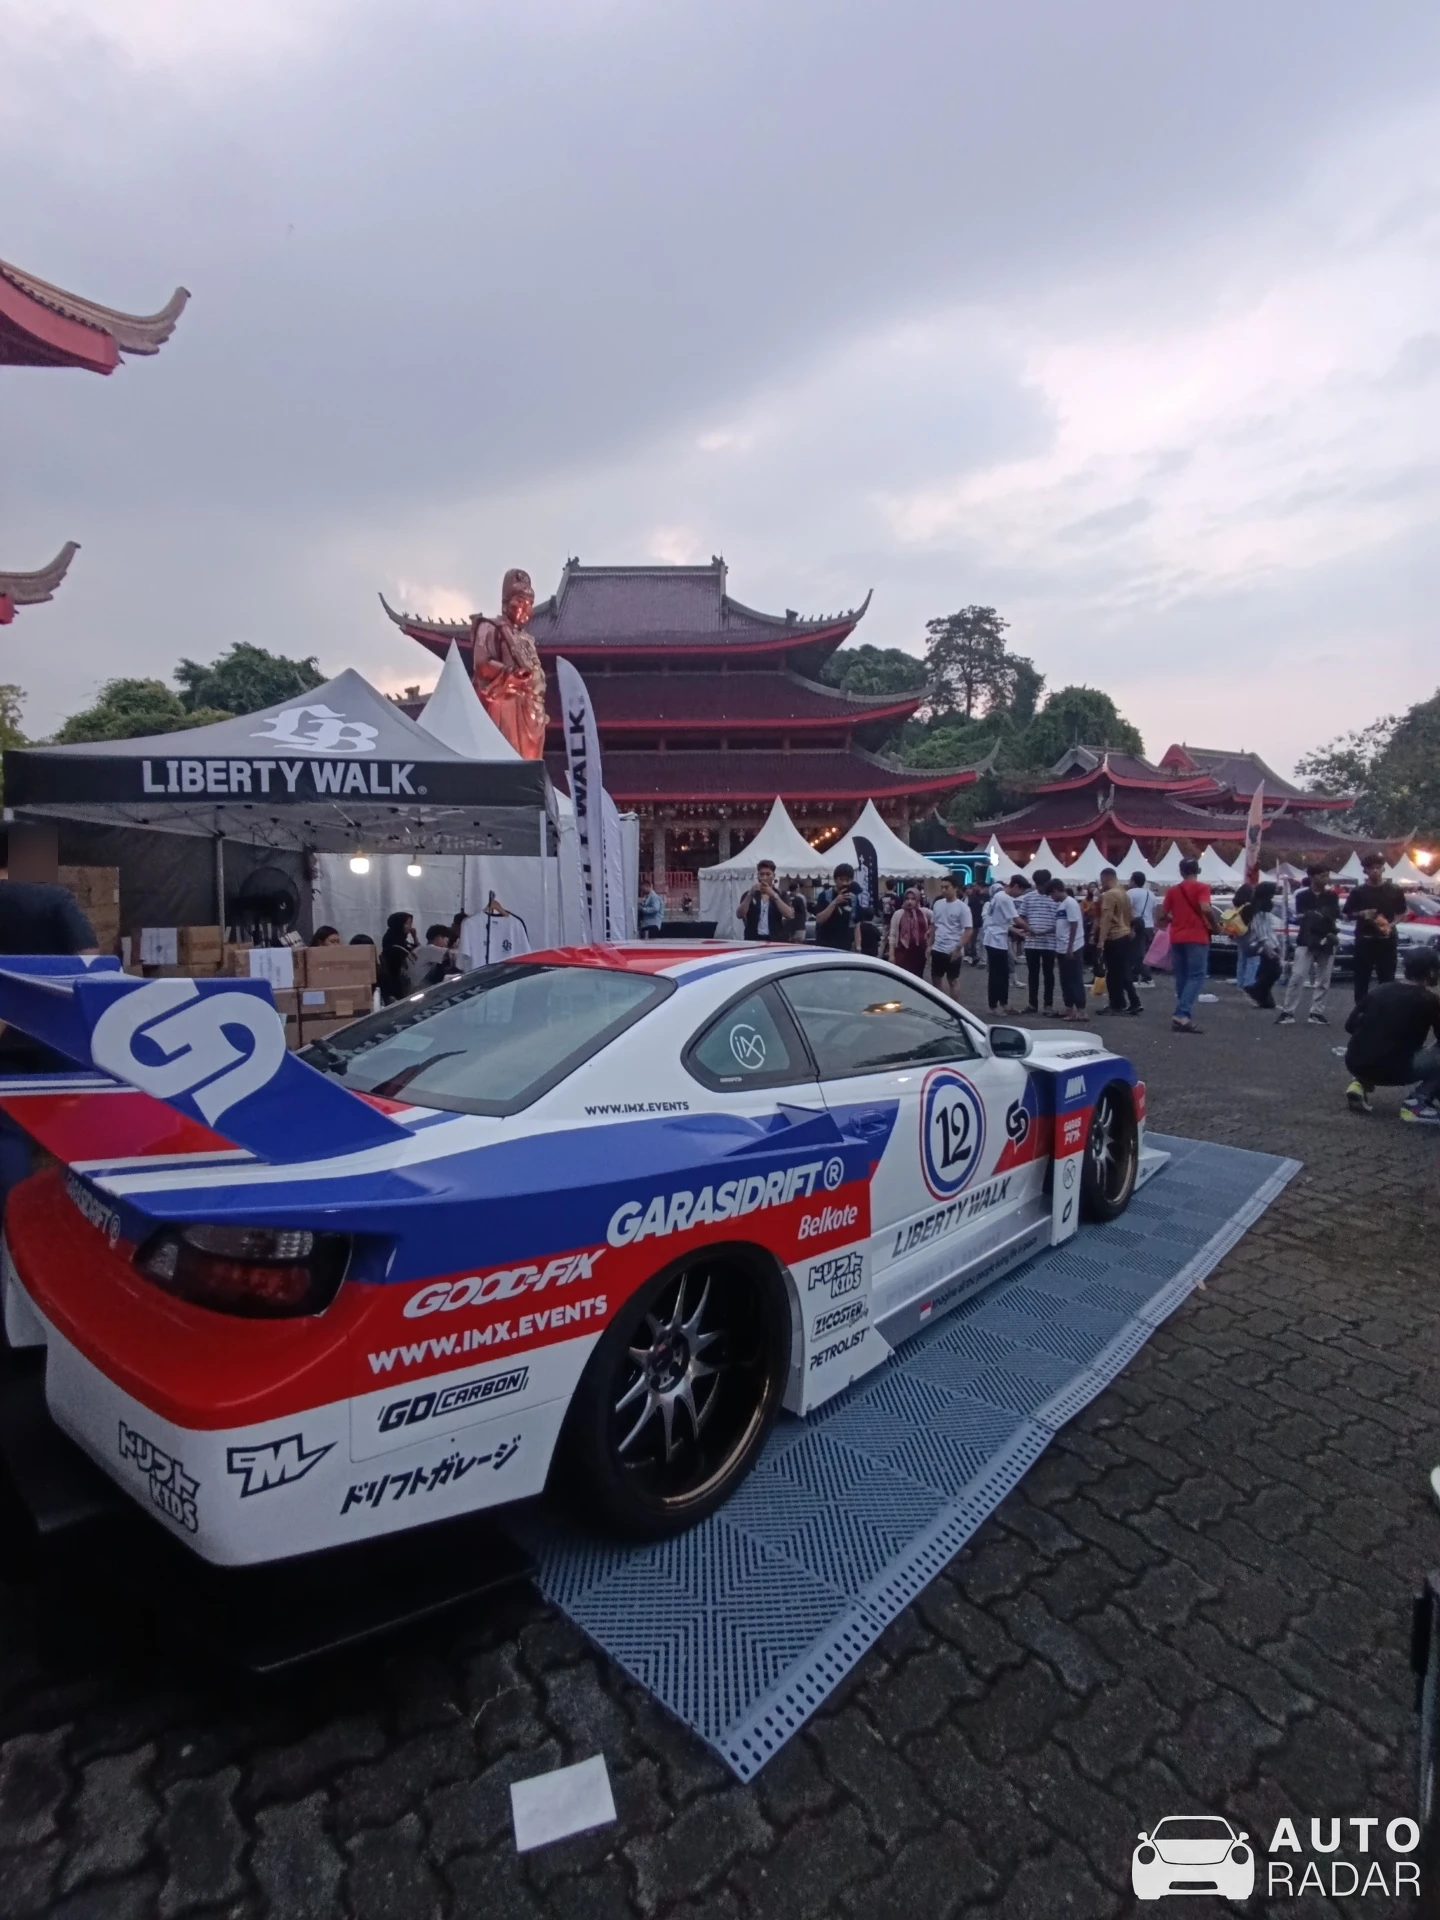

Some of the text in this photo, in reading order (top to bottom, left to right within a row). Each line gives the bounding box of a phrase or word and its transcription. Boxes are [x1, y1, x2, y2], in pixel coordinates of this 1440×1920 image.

[142, 760, 304, 793] LIBERTY
[568, 708, 590, 817] WALK
[584, 1101, 690, 1116] WWW.IMX.EVENTS
[935, 1102, 972, 1169] 12
[797, 1204, 858, 1240] Belkote
[892, 1176, 1011, 1259] LIBERTY WALK
[830, 1267, 862, 1299] KIDS
[367, 1295, 608, 1375] WWW.IMX.EVENTS
[440, 1373, 522, 1409] CARBON
[149, 1472, 199, 1533] KIDS
[340, 1434, 522, 1515] ドリフトガレージ
